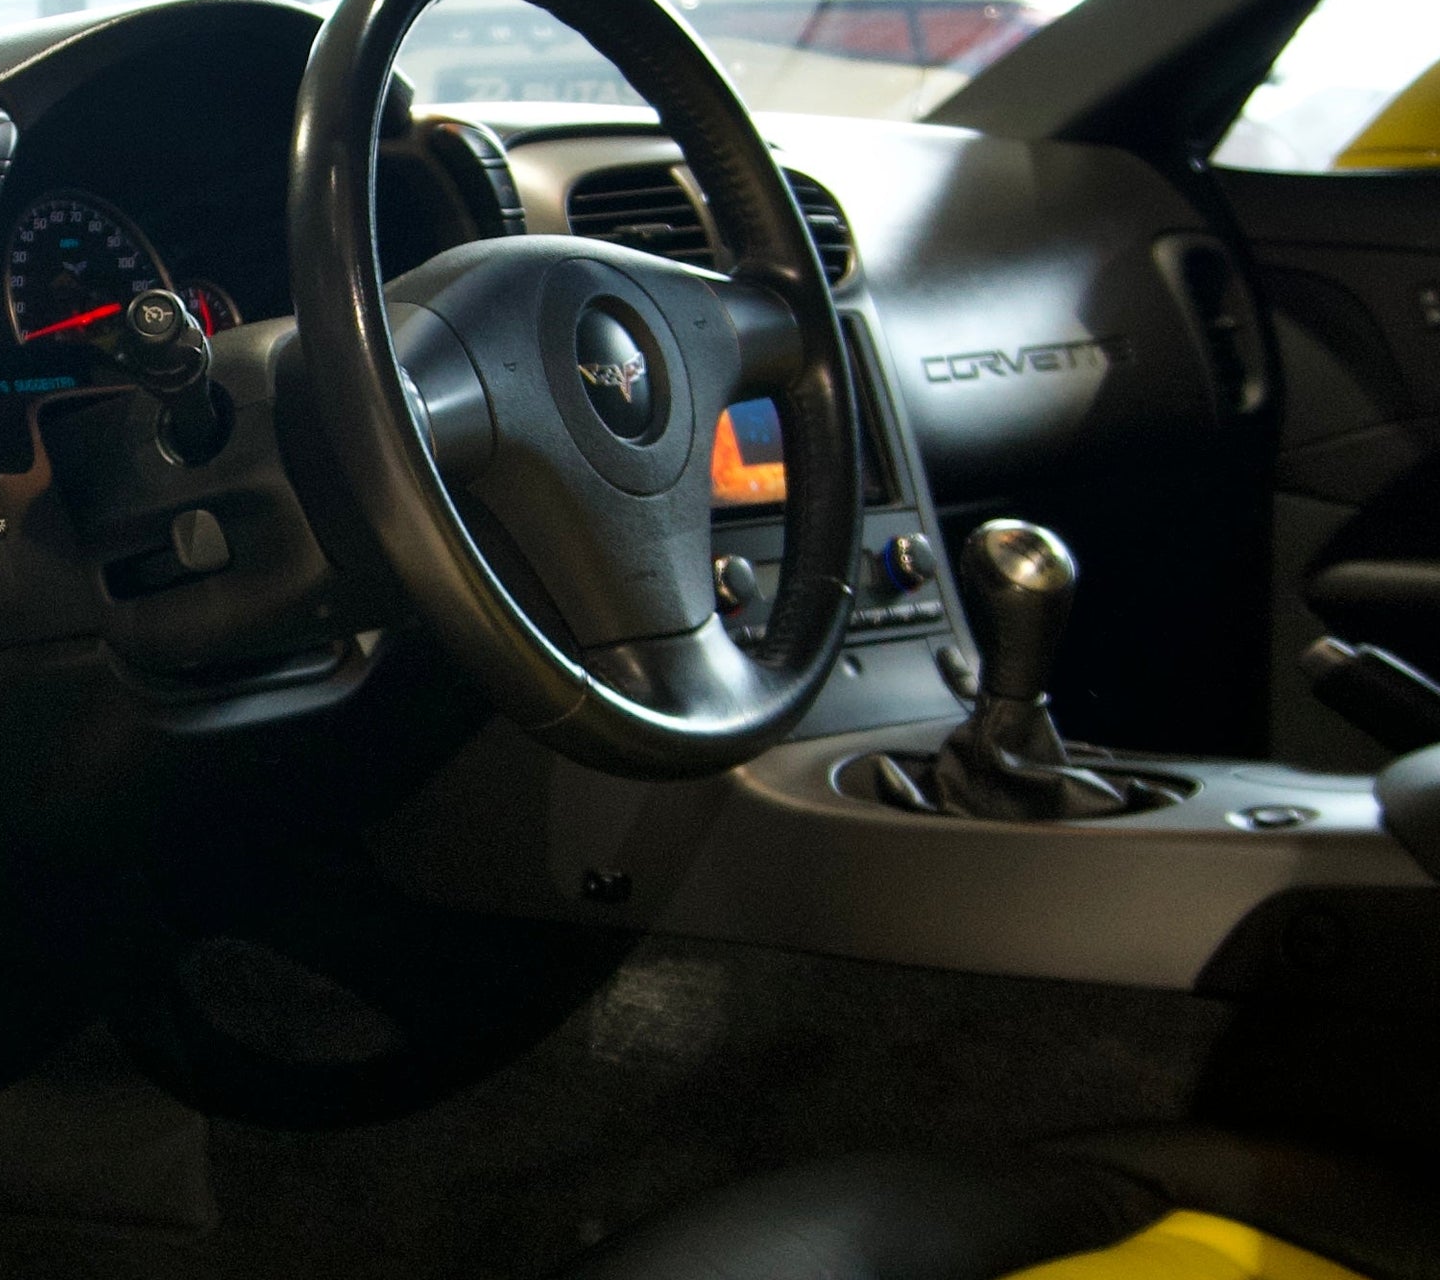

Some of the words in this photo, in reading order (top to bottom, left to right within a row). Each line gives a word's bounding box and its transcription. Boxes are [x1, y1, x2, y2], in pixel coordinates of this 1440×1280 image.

[50, 211, 64, 223] 60
[70, 211, 82, 222] 70
[33, 218, 47, 229] 50
[20, 231, 34, 242] 40
[12, 251, 26, 263] 30
[118, 257, 135, 269] 100
[921, 337, 1118, 382] CORVETT
